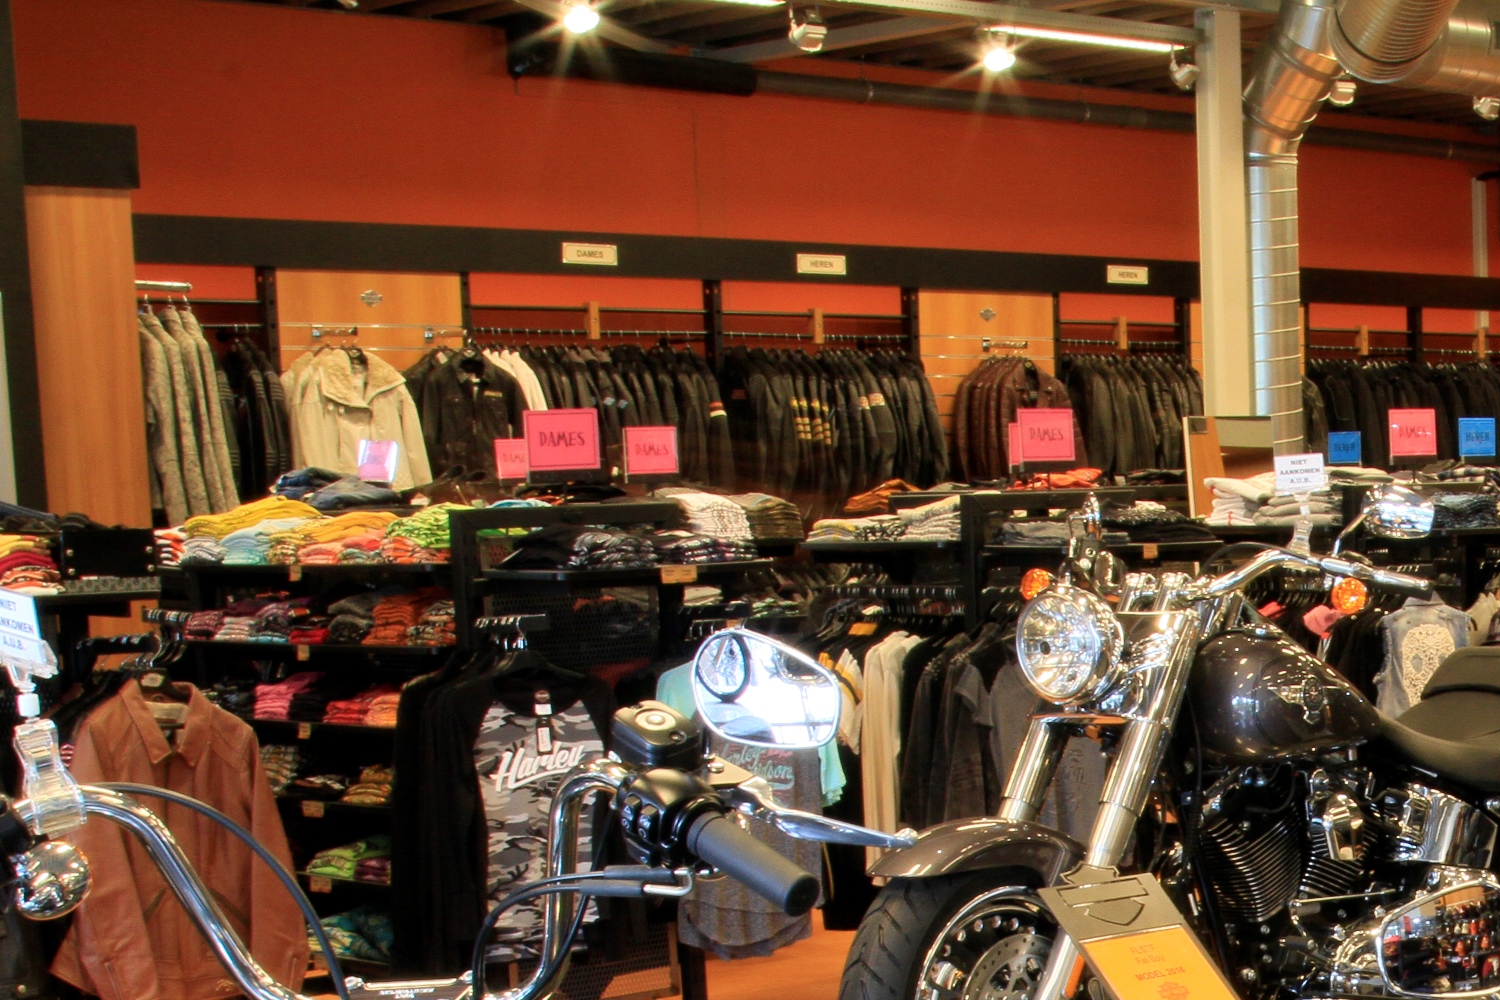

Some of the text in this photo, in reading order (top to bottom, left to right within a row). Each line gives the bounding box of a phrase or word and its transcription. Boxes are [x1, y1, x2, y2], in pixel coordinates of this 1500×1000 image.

[576, 249, 604, 259] DAMES
[810, 260, 834, 269] HEREN
[1118, 271, 1138, 279] HEREN
[1029, 427, 1064, 441] DAMES
[1399, 425, 1428, 439] DAMES
[1465, 431, 1490, 444] HEREN
[538, 431, 585, 447] DAMES
[635, 443, 669, 456] DAMES
[502, 451, 526, 464] DAME
[0, 617, 35, 635] NKOMEN
[489, 741, 586, 792] Harley
[1135, 966, 1186, 981] MODEL 2016
